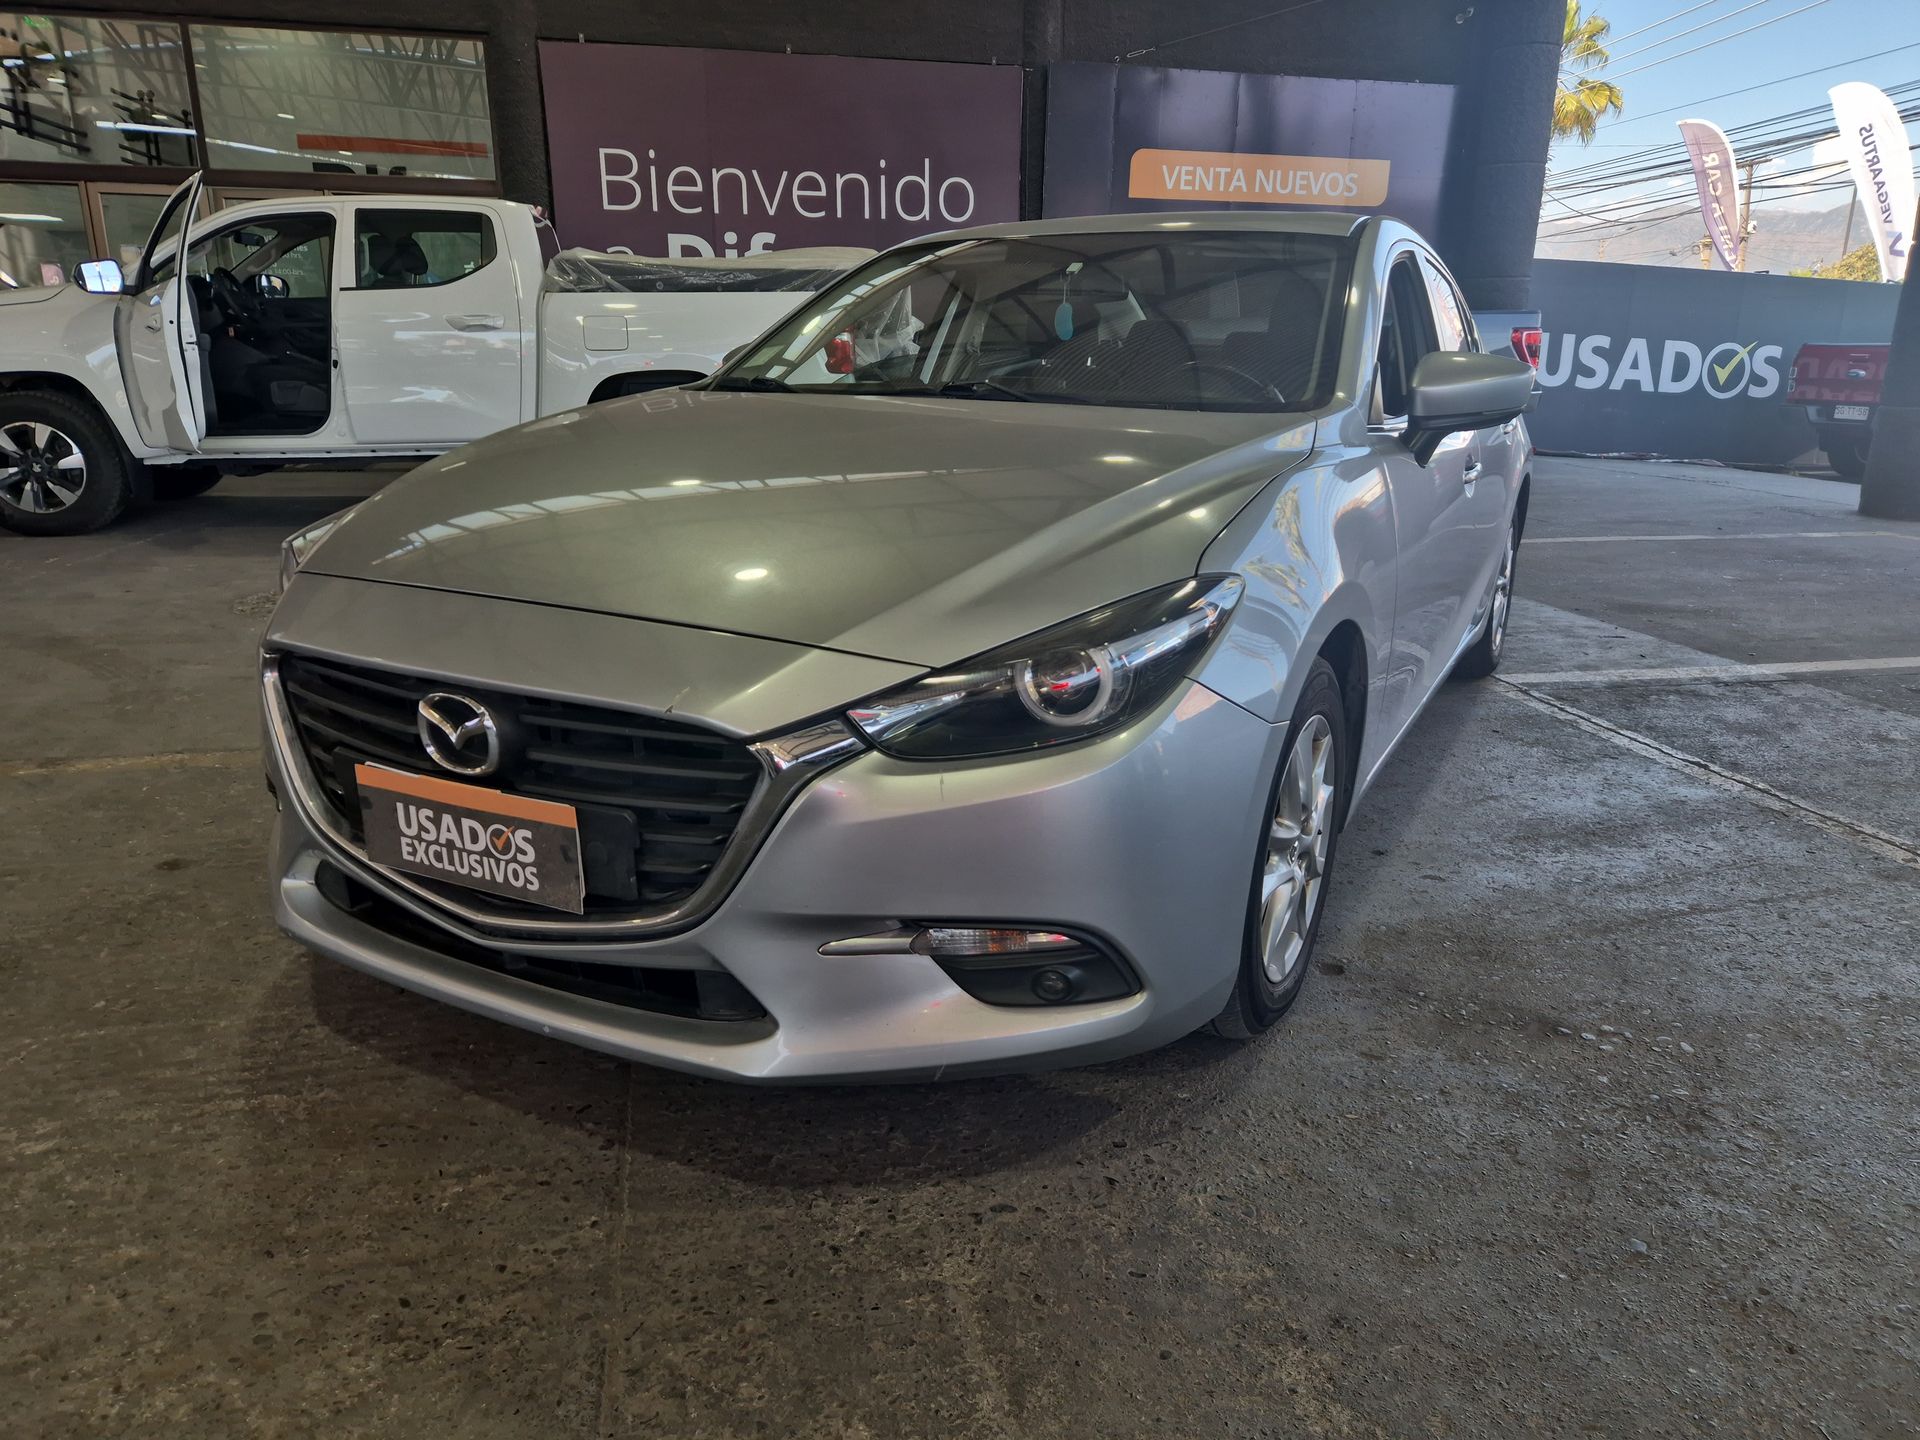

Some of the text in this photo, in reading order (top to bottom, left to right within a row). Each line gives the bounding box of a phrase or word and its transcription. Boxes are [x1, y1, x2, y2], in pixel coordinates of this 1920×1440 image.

[599, 147, 975, 223] Bienvenido
[1162, 165, 1359, 198] VENTA NUEVOS
[1534, 332, 1783, 399] USADOS
[396, 802, 536, 862] USADOS
[401, 836, 540, 891] EXCLUSIVOS
